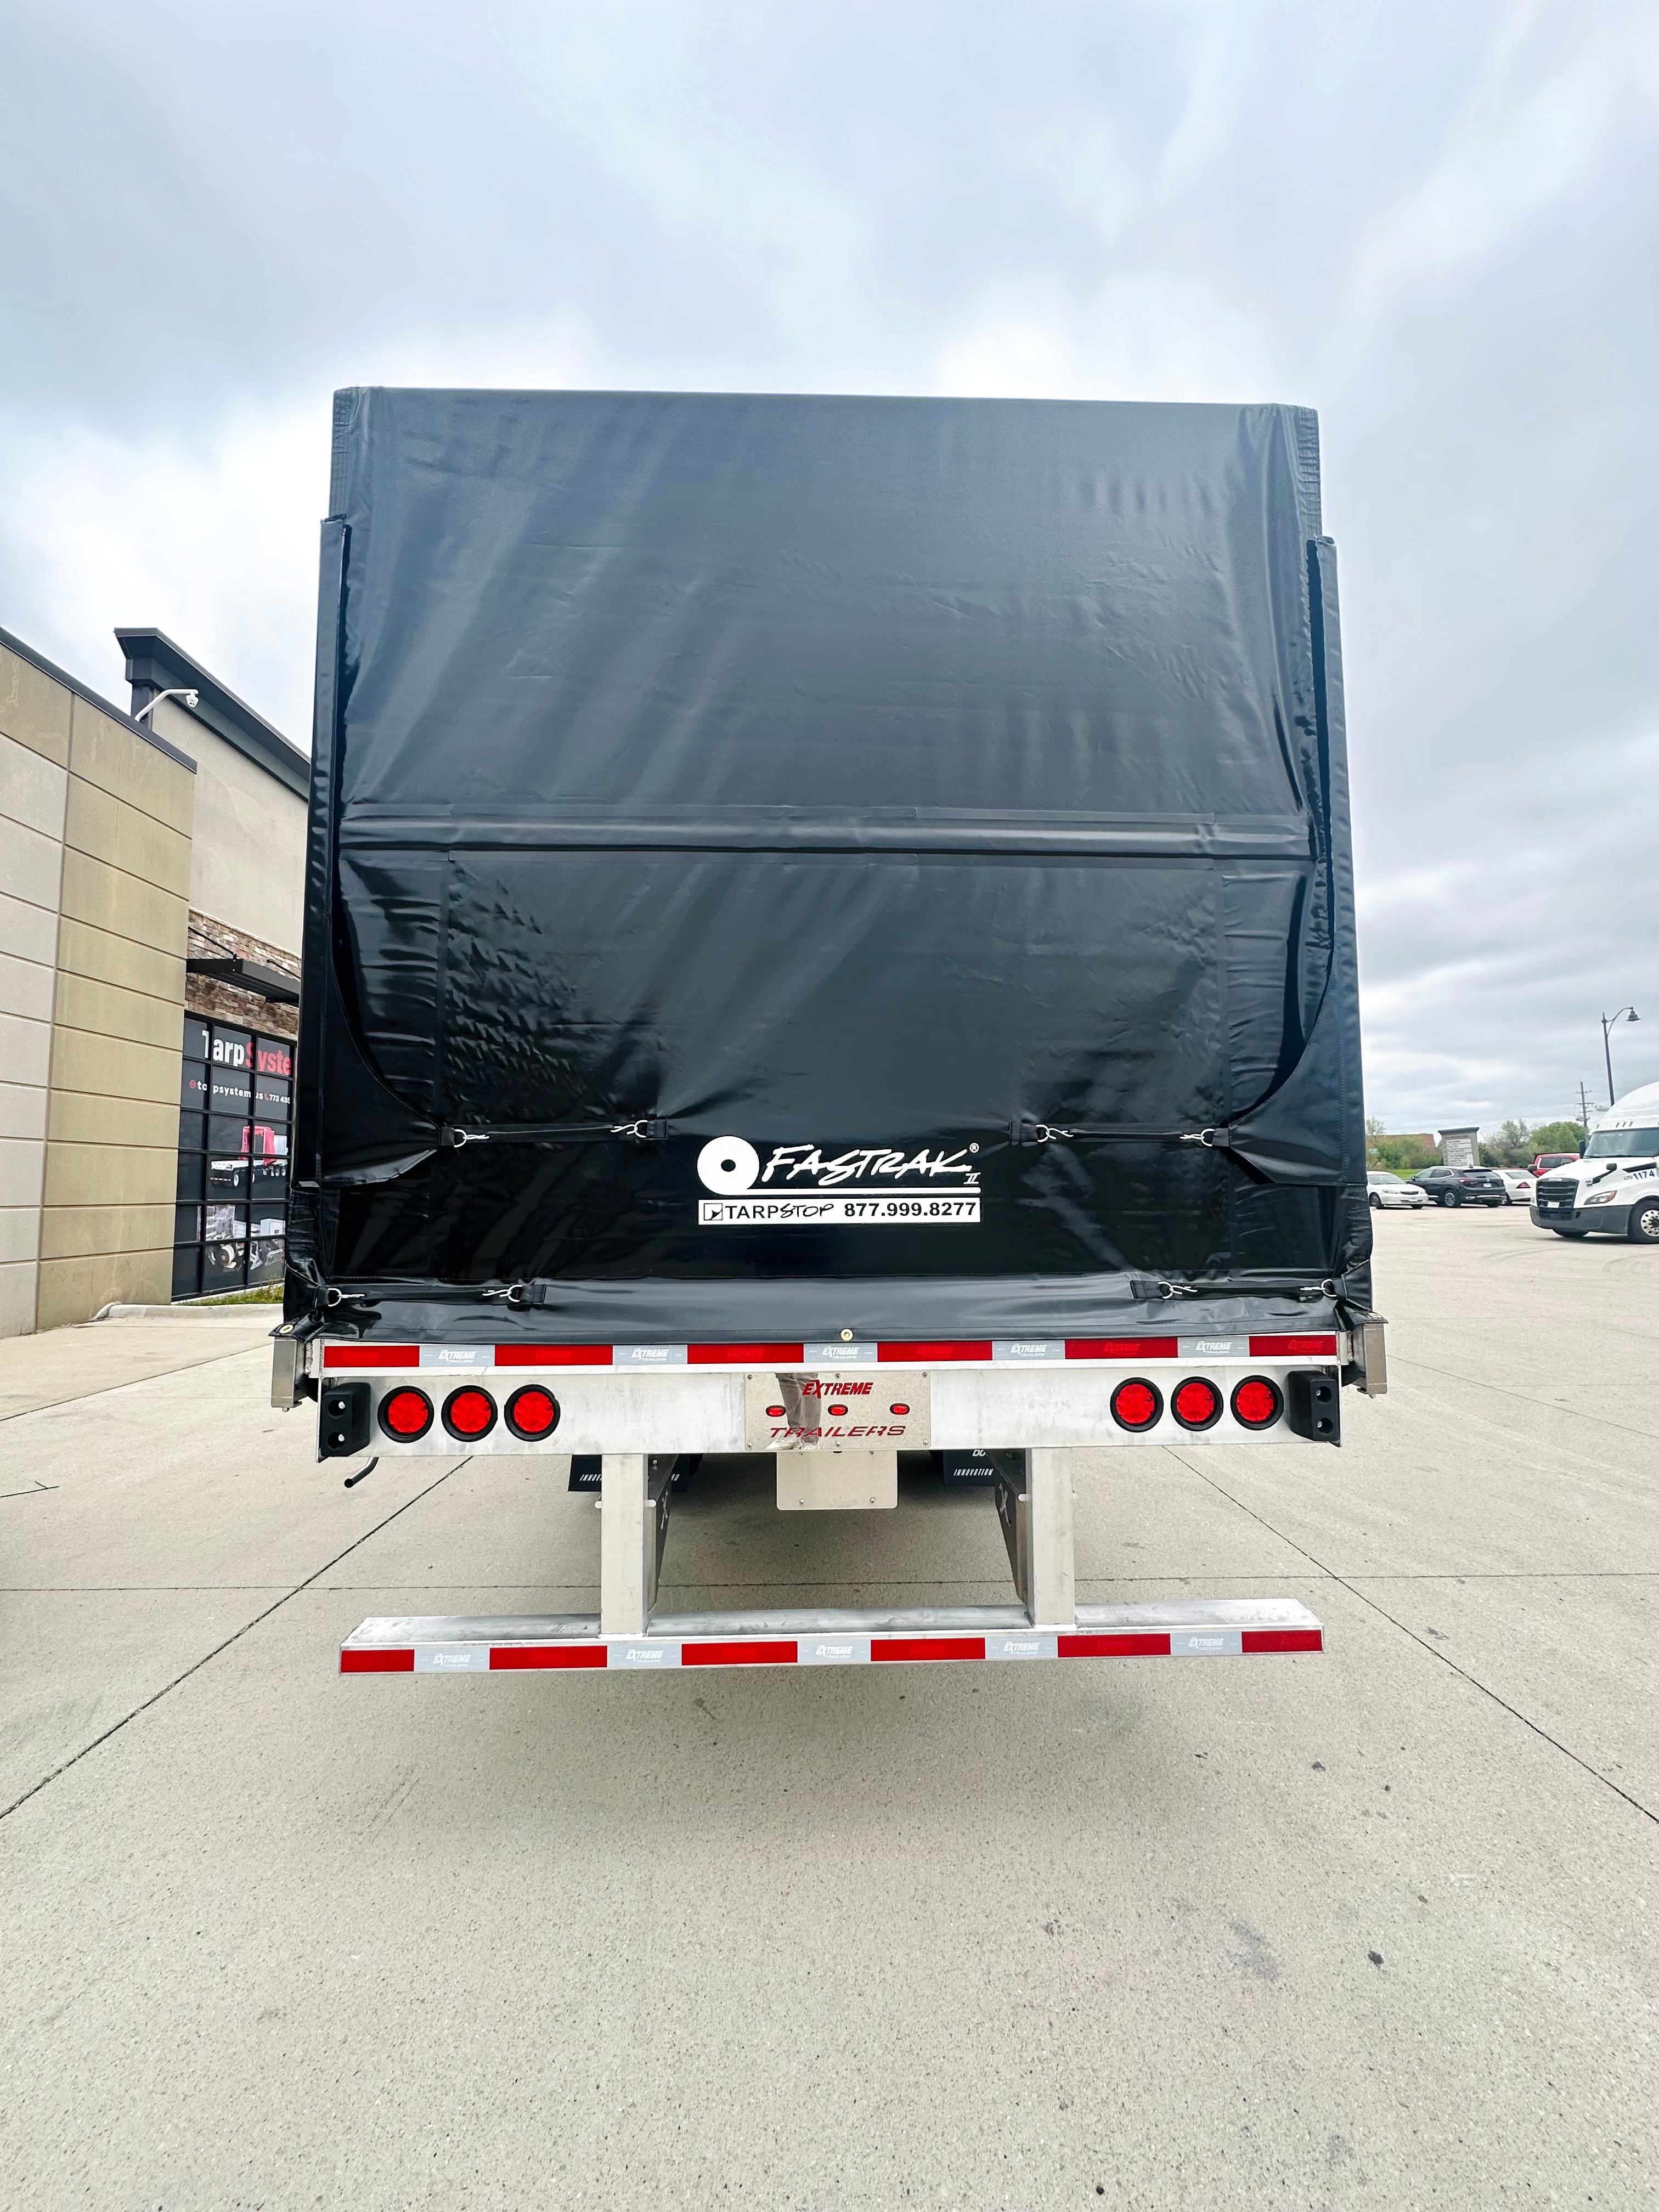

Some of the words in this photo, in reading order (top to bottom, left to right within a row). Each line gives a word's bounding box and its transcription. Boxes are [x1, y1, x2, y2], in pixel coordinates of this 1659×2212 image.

[269, 1093, 280, 1102] 773
[761, 1144, 972, 1186] FASTRAK
[1633, 1170, 1655, 1180] 1174
[725, 1203, 834, 1220] TARPSTOP
[844, 1201, 977, 1217] 877.999.8277
[631, 1347, 669, 1359] EXTREME
[822, 1345, 860, 1357] EXTREME
[1011, 1343, 1047, 1355] EXTREME
[1195, 1340, 1232, 1353] EXTREME
[438, 1349, 477, 1362] EXTREME
[802, 1379, 874, 1399] EXTREME
[770, 1425, 906, 1438] TRAILERS
[953, 1468, 994, 1476] INNOVATION
[1003, 1641, 1040, 1654] EXTREME
[1188, 1637, 1224, 1649] EXTREME
[625, 1649, 664, 1662] EXTREME
[816, 1644, 853, 1657] EXTREME
[433, 1653, 472, 1666] EXTREME
